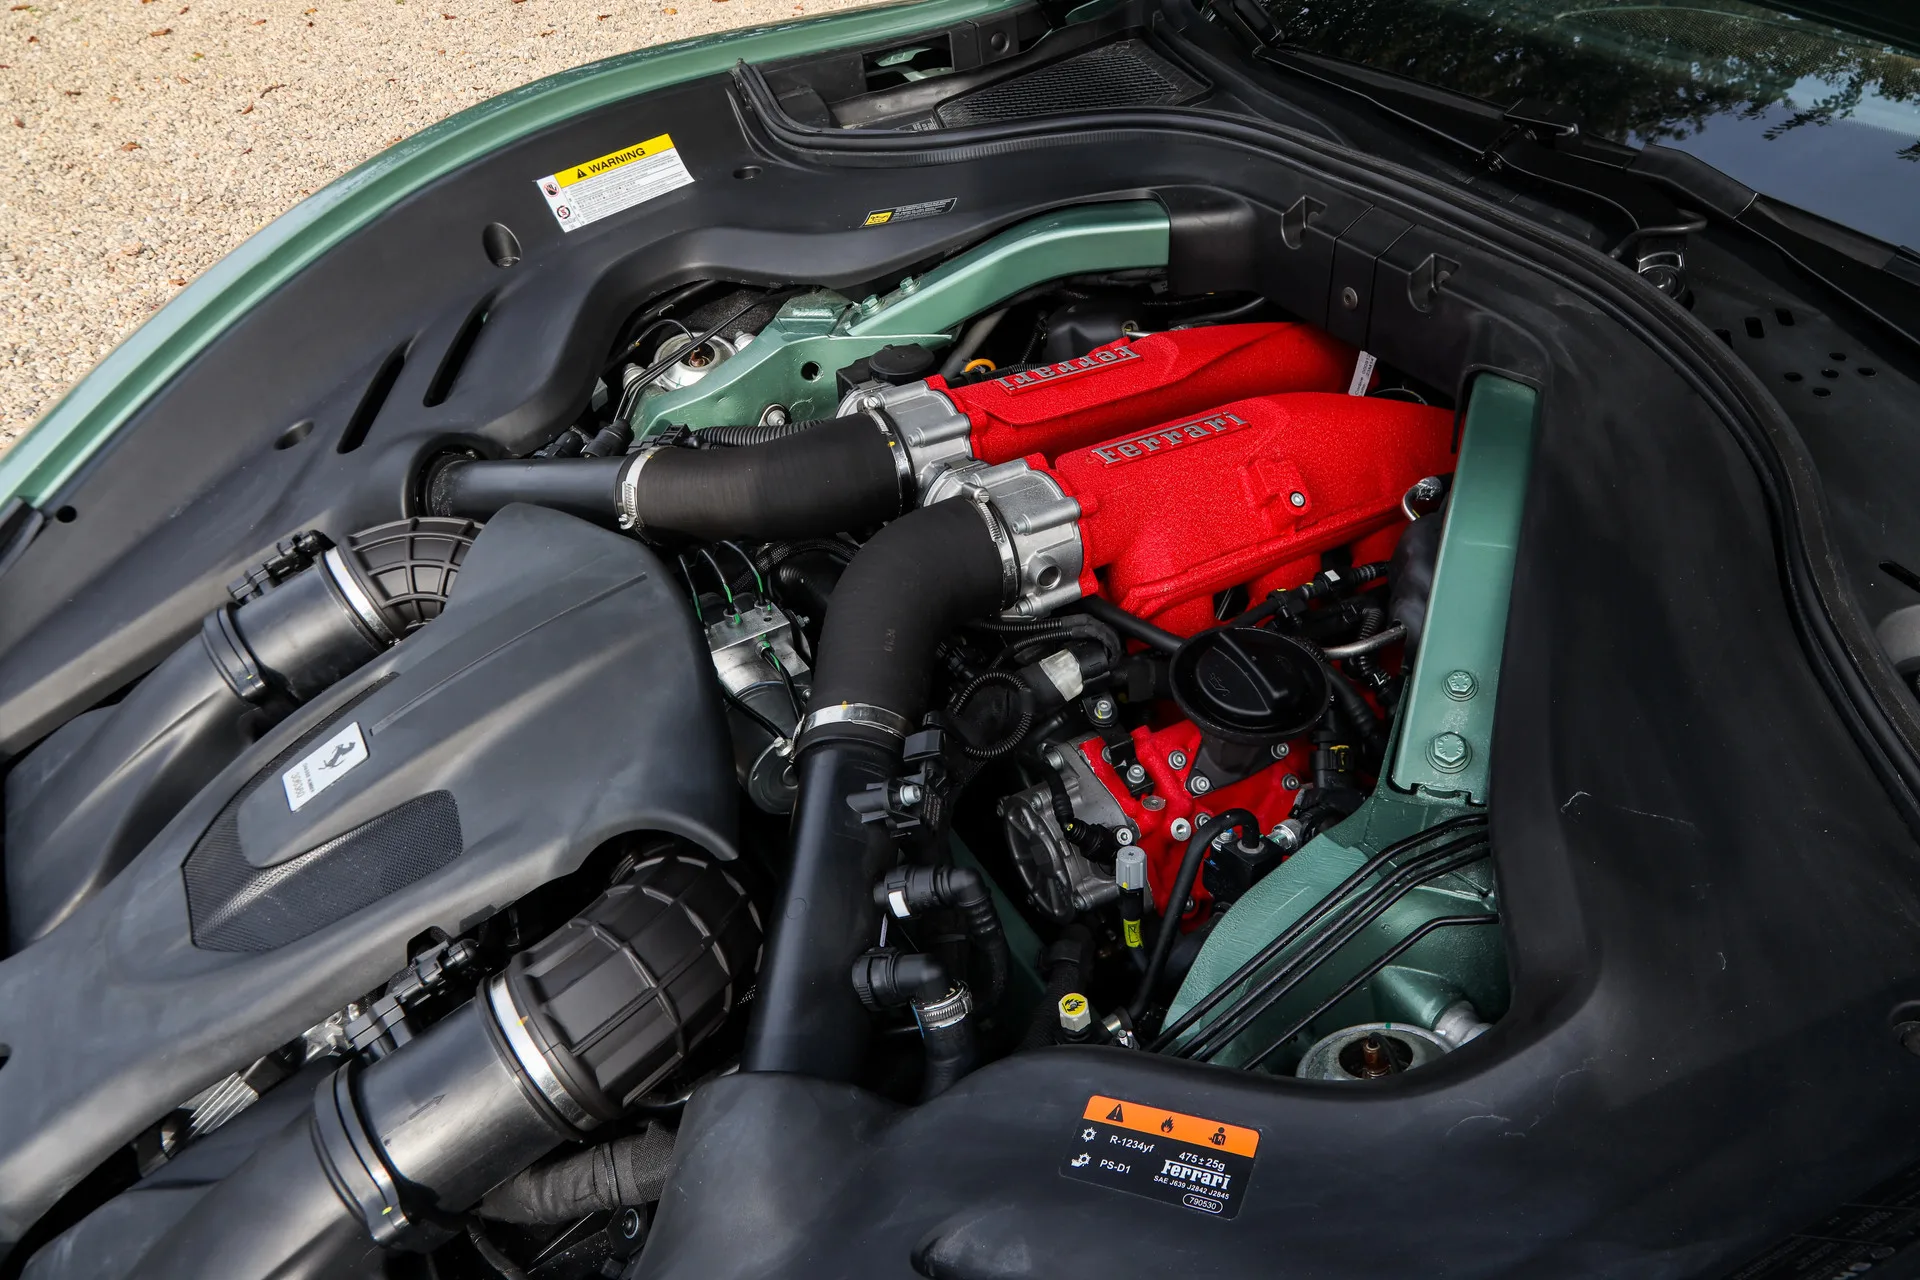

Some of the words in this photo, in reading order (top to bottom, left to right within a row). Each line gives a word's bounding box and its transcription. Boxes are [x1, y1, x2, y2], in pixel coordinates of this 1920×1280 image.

[588, 147, 646, 173] WARNING
[994, 345, 1141, 391] Ferrari
[1091, 411, 1248, 465] Ferrari
[1109, 1134, 1155, 1153] R-1234yf
[1099, 1158, 1131, 1174] PS-D1
[1160, 1159, 1232, 1190] Ferrari
[1153, 1175, 1169, 1185] SAE
[1169, 1178, 1187, 1190] J639
[1186, 1183, 1208, 1195] J2842
[1208, 1188, 1230, 1201] J2845
[1188, 1196, 1218, 1211] 790530
